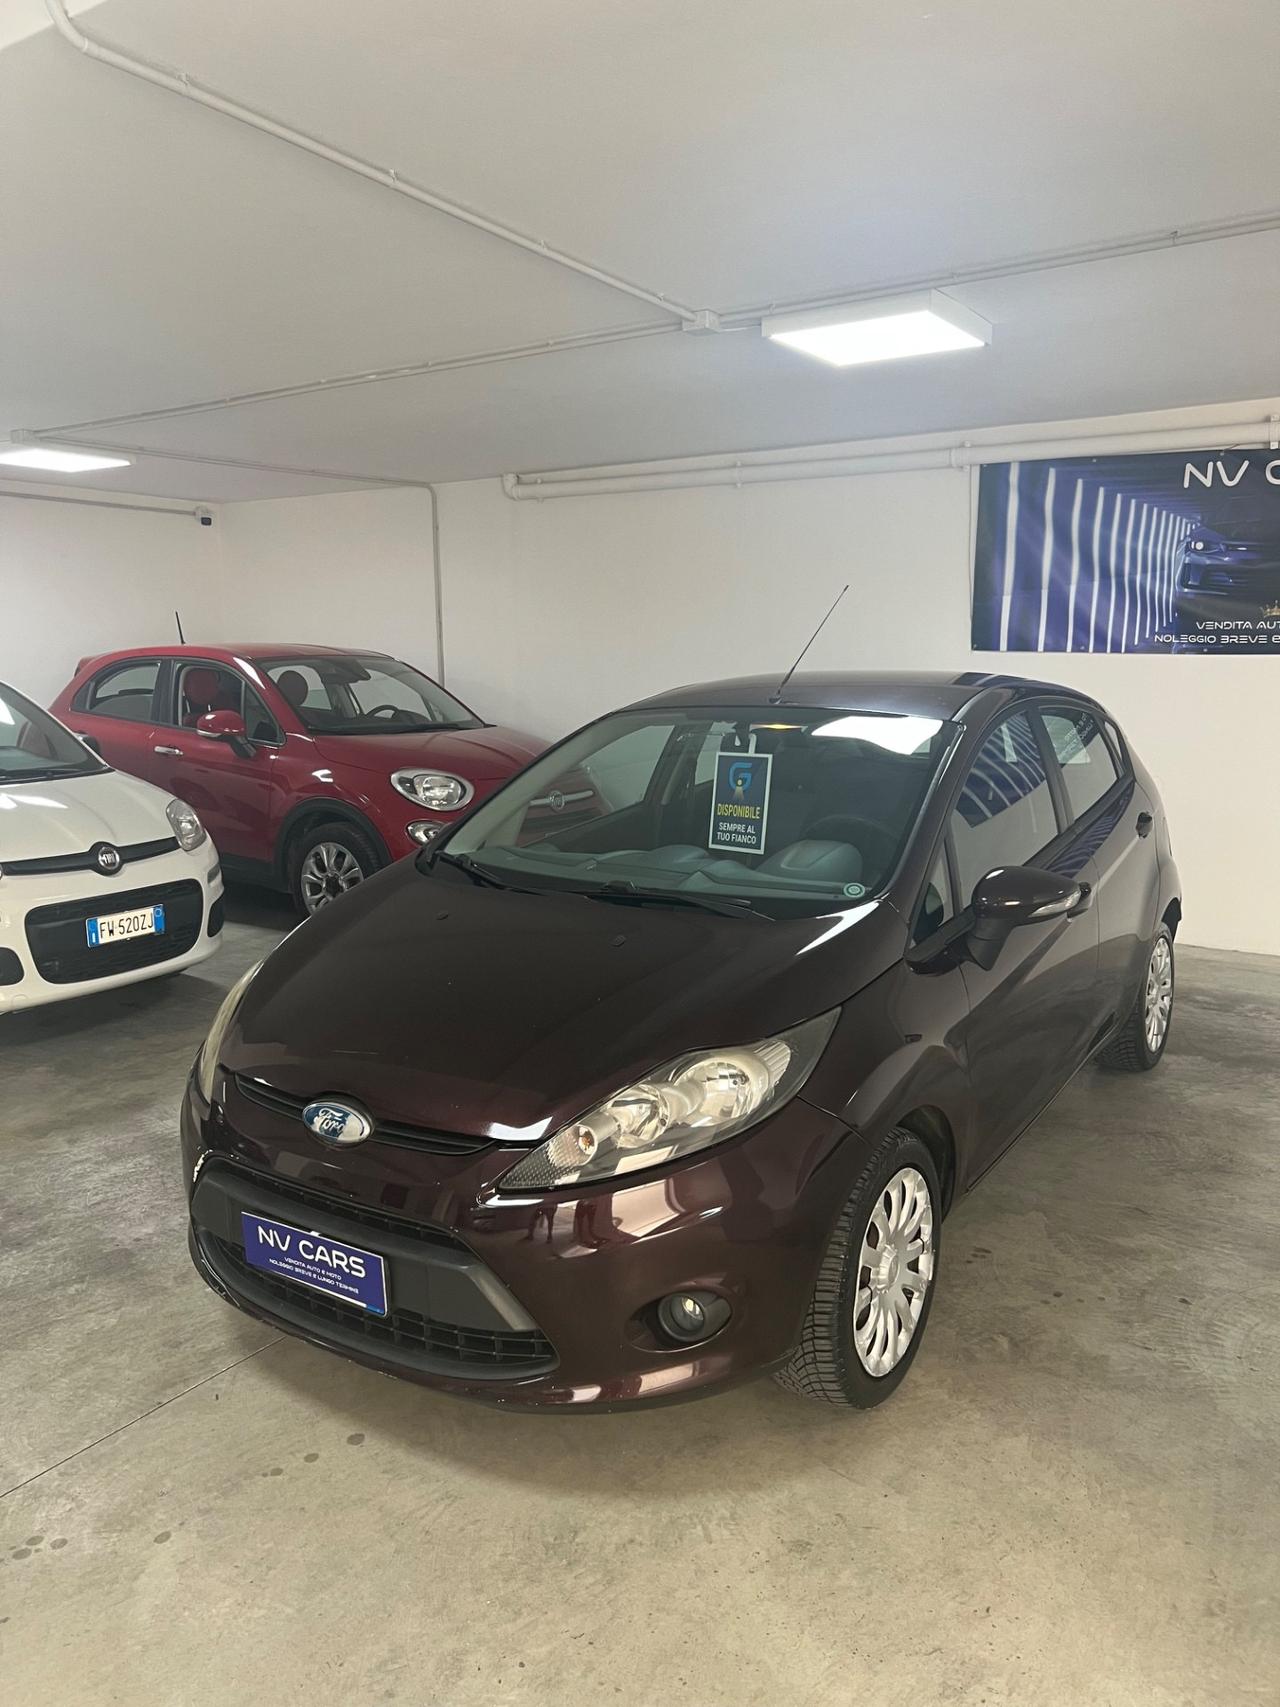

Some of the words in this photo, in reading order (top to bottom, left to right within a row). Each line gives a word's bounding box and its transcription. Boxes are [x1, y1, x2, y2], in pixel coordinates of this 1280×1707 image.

[1183, 460, 1250, 489] NV
[1196, 621, 1252, 630] VENDITA
[1154, 634, 1216, 643] NOLEGGIO
[1220, 635, 1268, 644] BREVE
[717, 804, 760, 819] DISPONIBILE
[719, 822, 745, 833] SEMPRE
[747, 825, 755, 834] AL
[717, 832, 730, 841] TUO
[731, 834, 756, 845] FIANCO
[100, 920, 114, 938] FW
[118, 912, 153, 935] 520ZJ
[257, 1225, 291, 1251] NV
[298, 1240, 366, 1278] CARS
